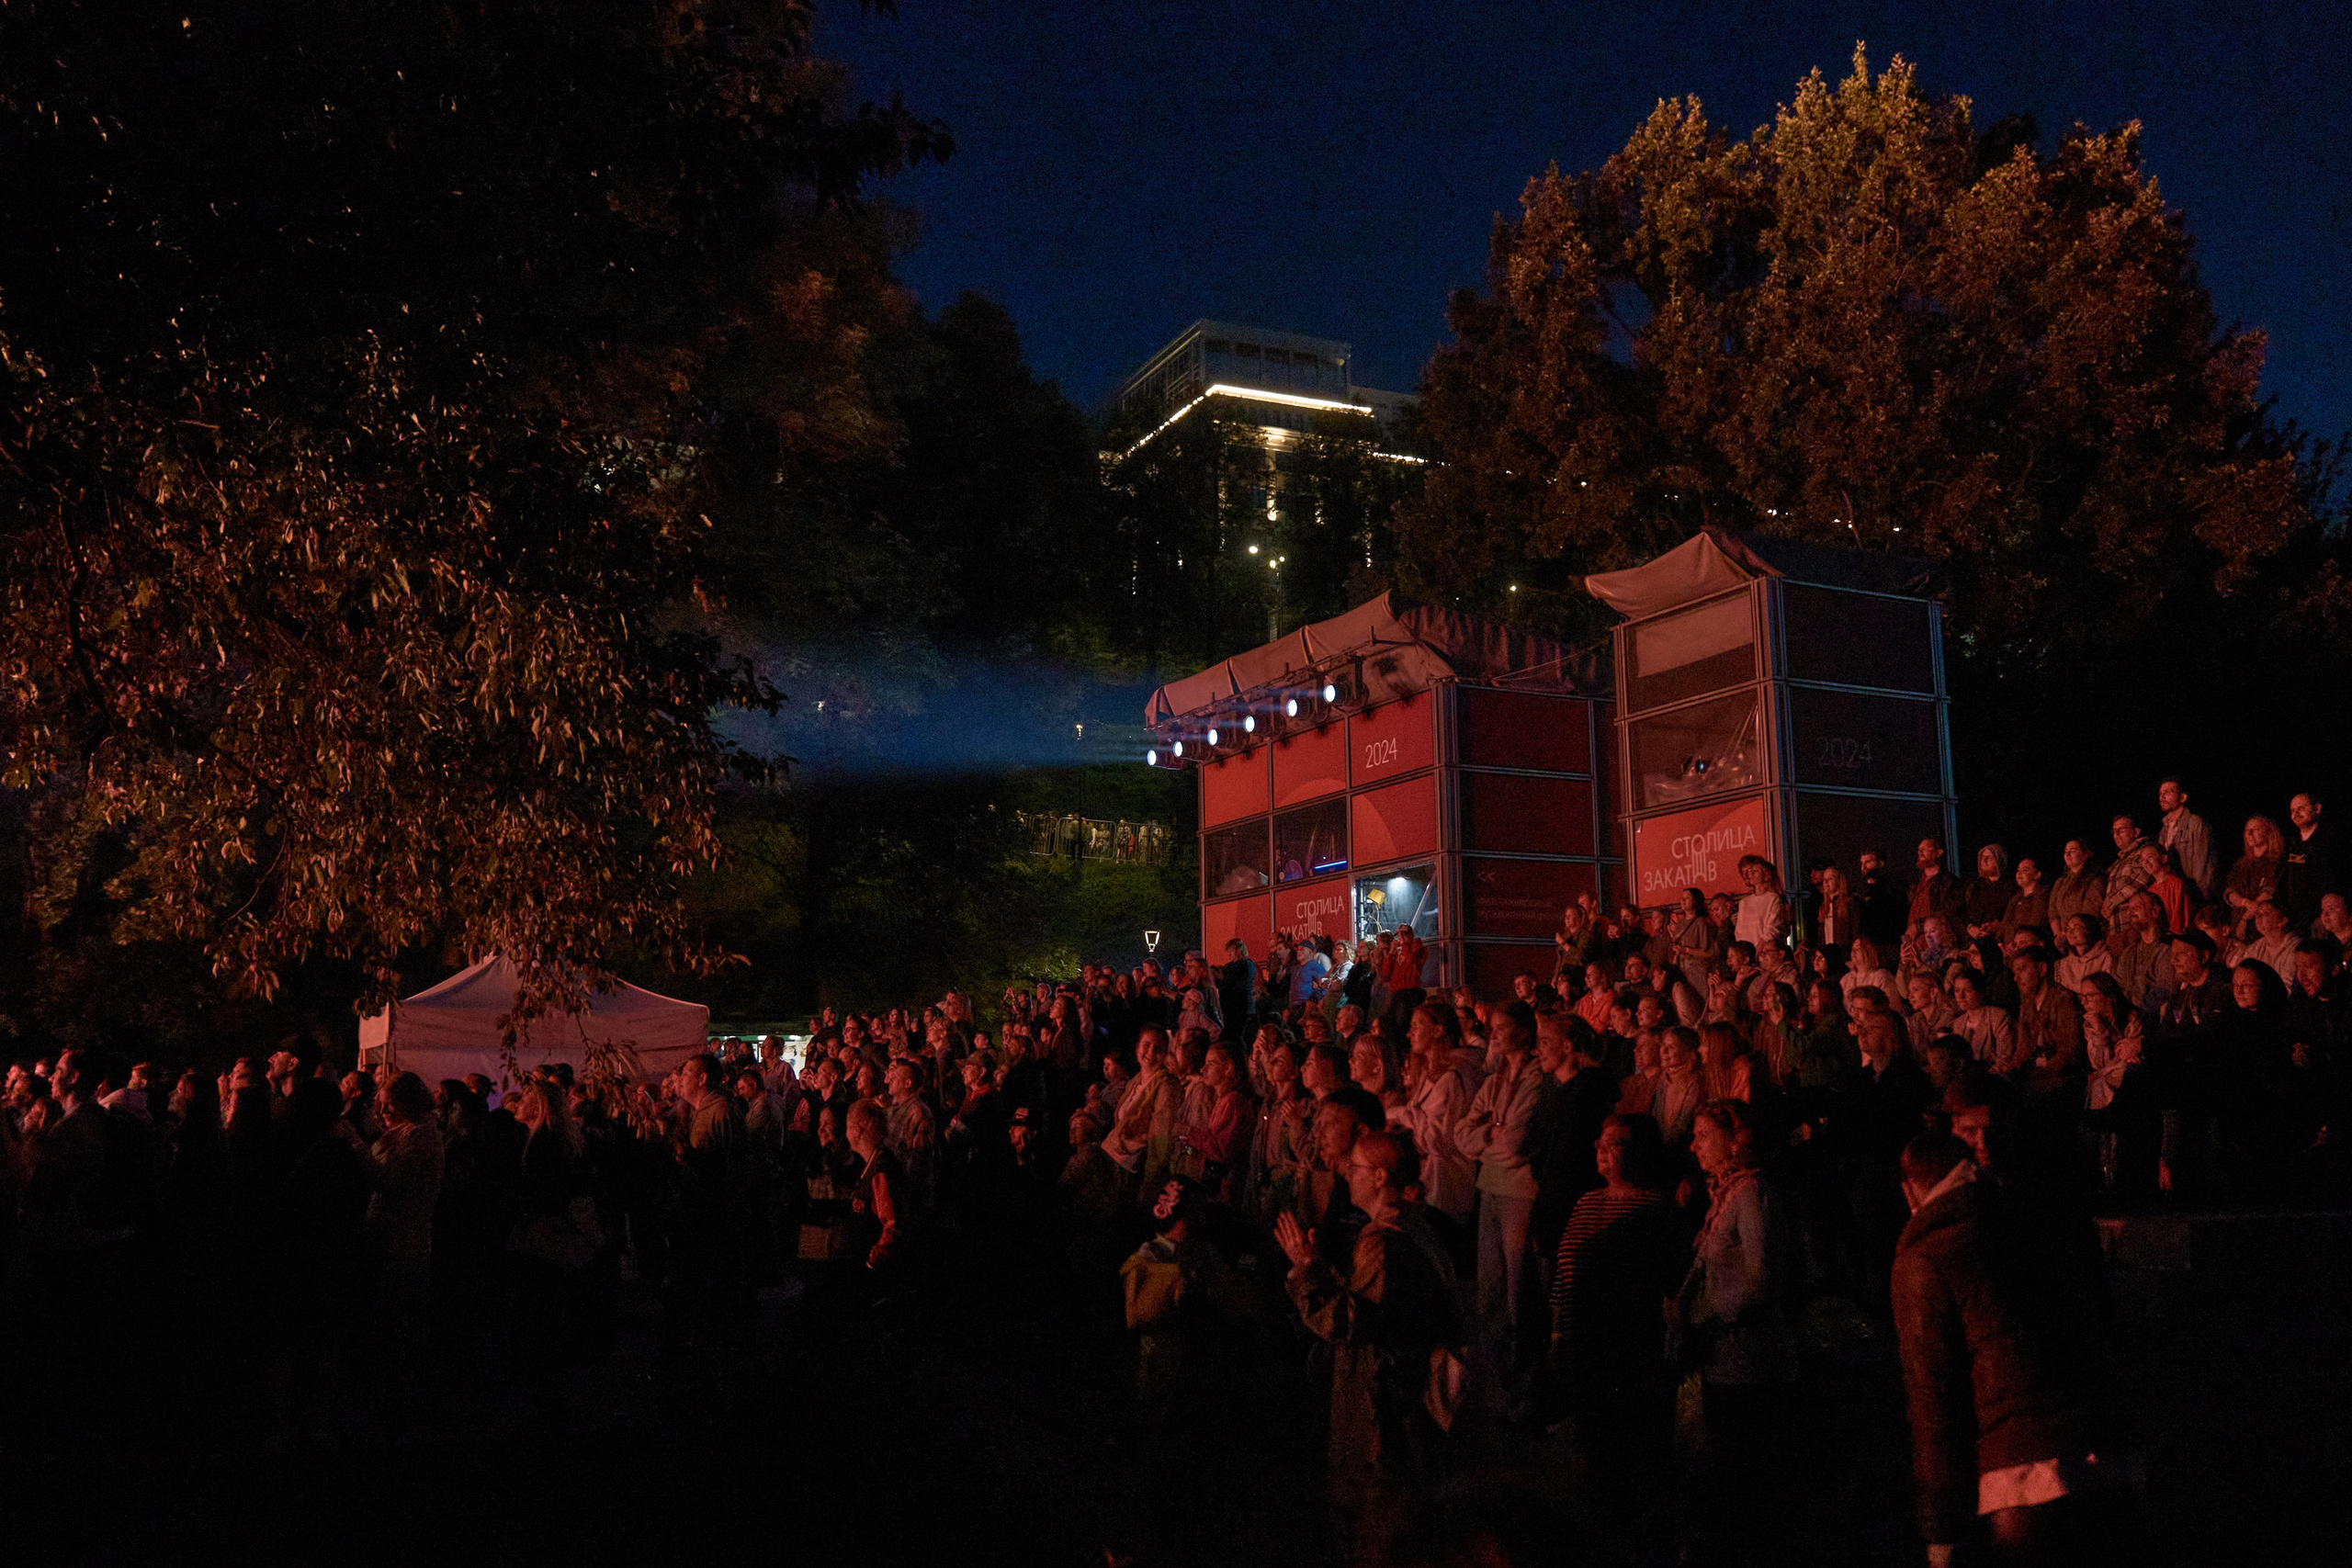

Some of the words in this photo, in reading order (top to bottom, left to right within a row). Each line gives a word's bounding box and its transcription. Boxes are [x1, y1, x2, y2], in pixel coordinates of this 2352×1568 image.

[1365, 738, 1397, 768] 2024
[1817, 736, 1872, 769] 2024
[1671, 825, 1756, 859] СТОЛИЦА
[1296, 896, 1344, 919] СТОЛИЦА
